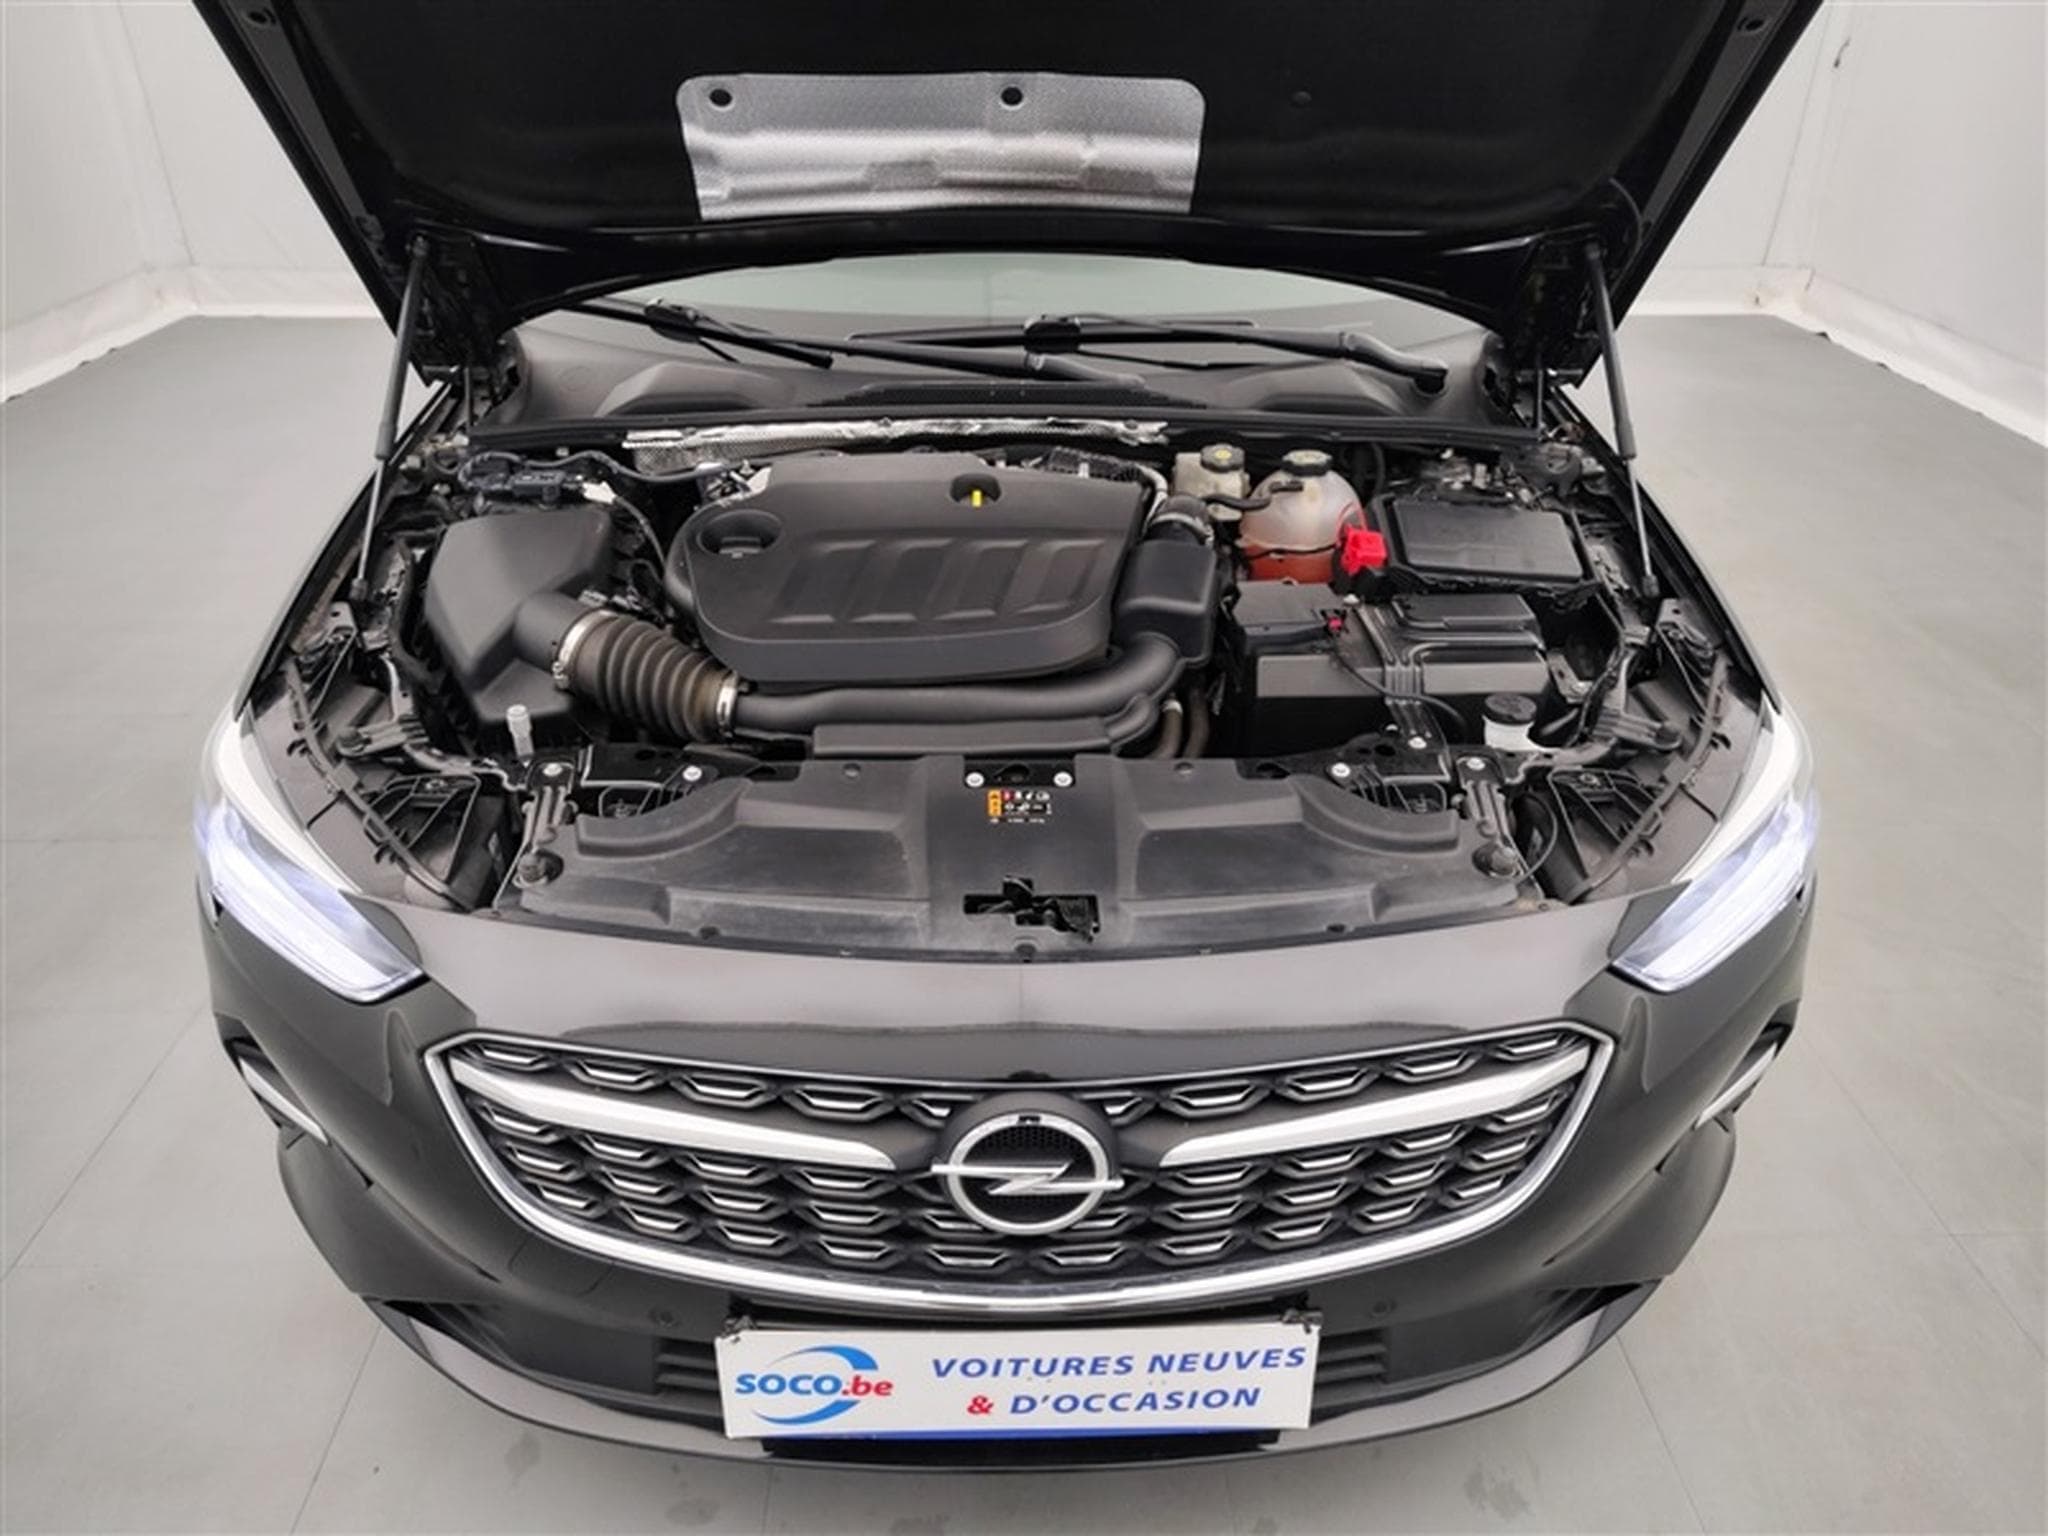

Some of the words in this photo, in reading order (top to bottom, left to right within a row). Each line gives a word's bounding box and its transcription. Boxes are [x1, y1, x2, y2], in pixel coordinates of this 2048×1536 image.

[932, 1355, 1133, 1378] VOITURES
[1148, 1346, 1306, 1373] NEUVES
[735, 1371, 894, 1397] SOCO.be
[966, 1394, 994, 1416] &
[1010, 1387, 1260, 1415] D'OCCASION
